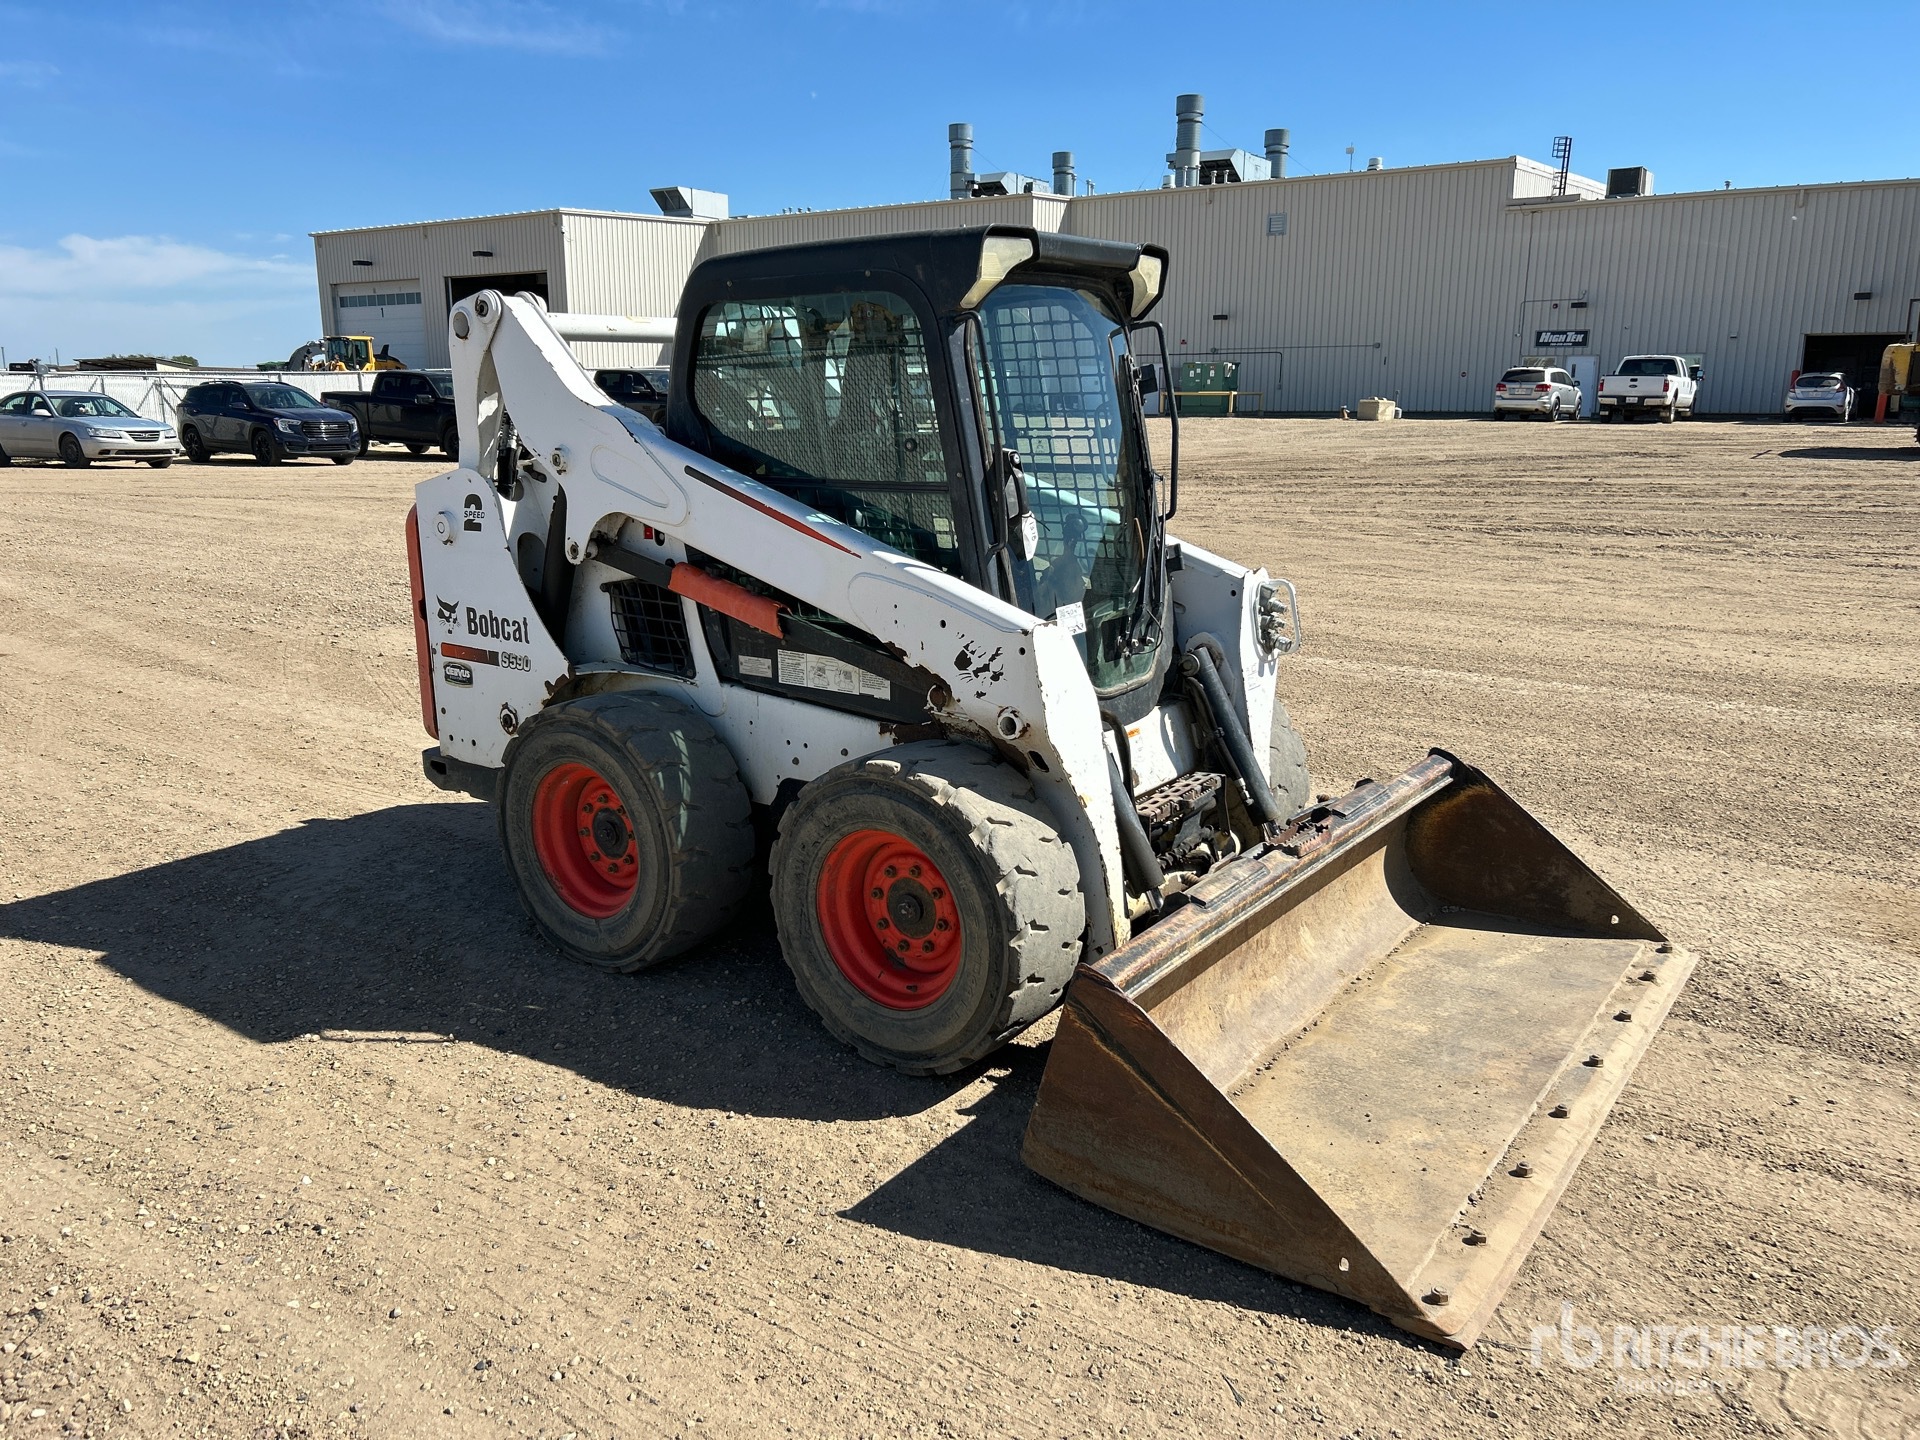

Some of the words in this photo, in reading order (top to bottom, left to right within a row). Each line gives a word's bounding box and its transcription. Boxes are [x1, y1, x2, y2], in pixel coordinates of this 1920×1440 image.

[464, 510, 485, 520] SPEED
[466, 606, 530, 645] Bobcat
[501, 651, 531, 672] S590
